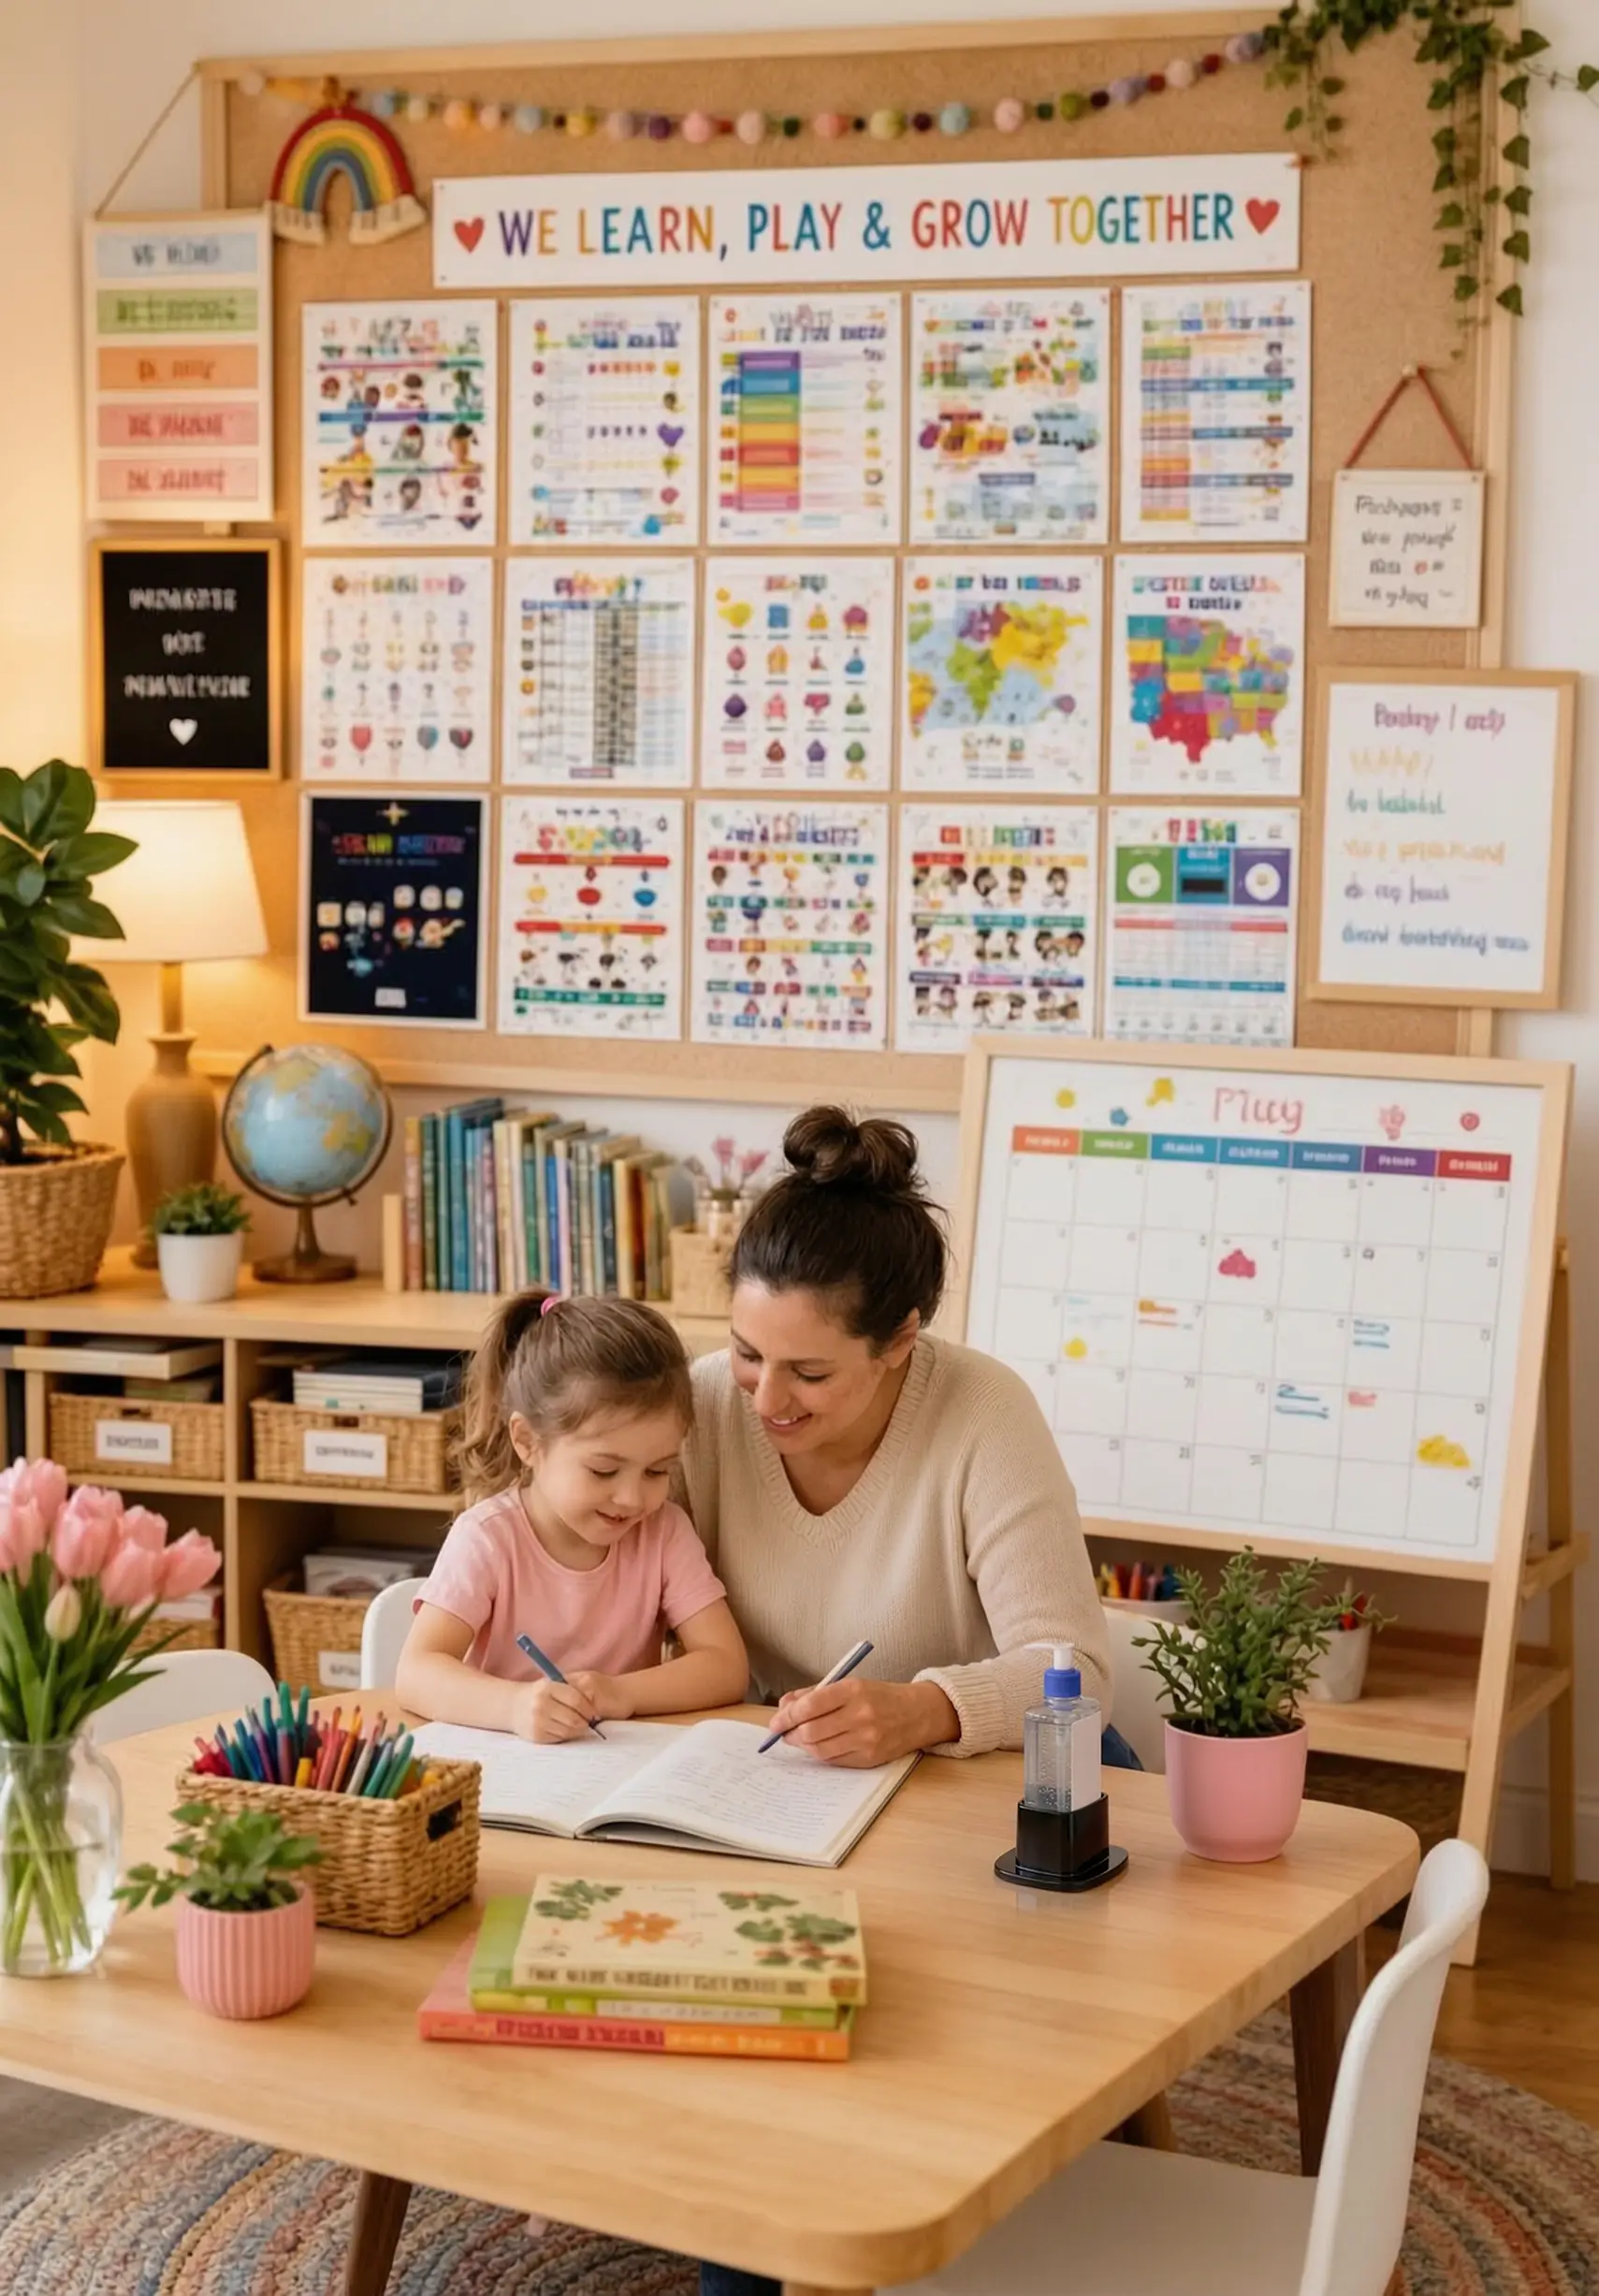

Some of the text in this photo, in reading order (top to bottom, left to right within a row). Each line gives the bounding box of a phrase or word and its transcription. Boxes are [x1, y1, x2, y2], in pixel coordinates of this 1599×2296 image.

[497, 192, 1235, 262] WE LEARN, PLAY & GROW TOGETHER
